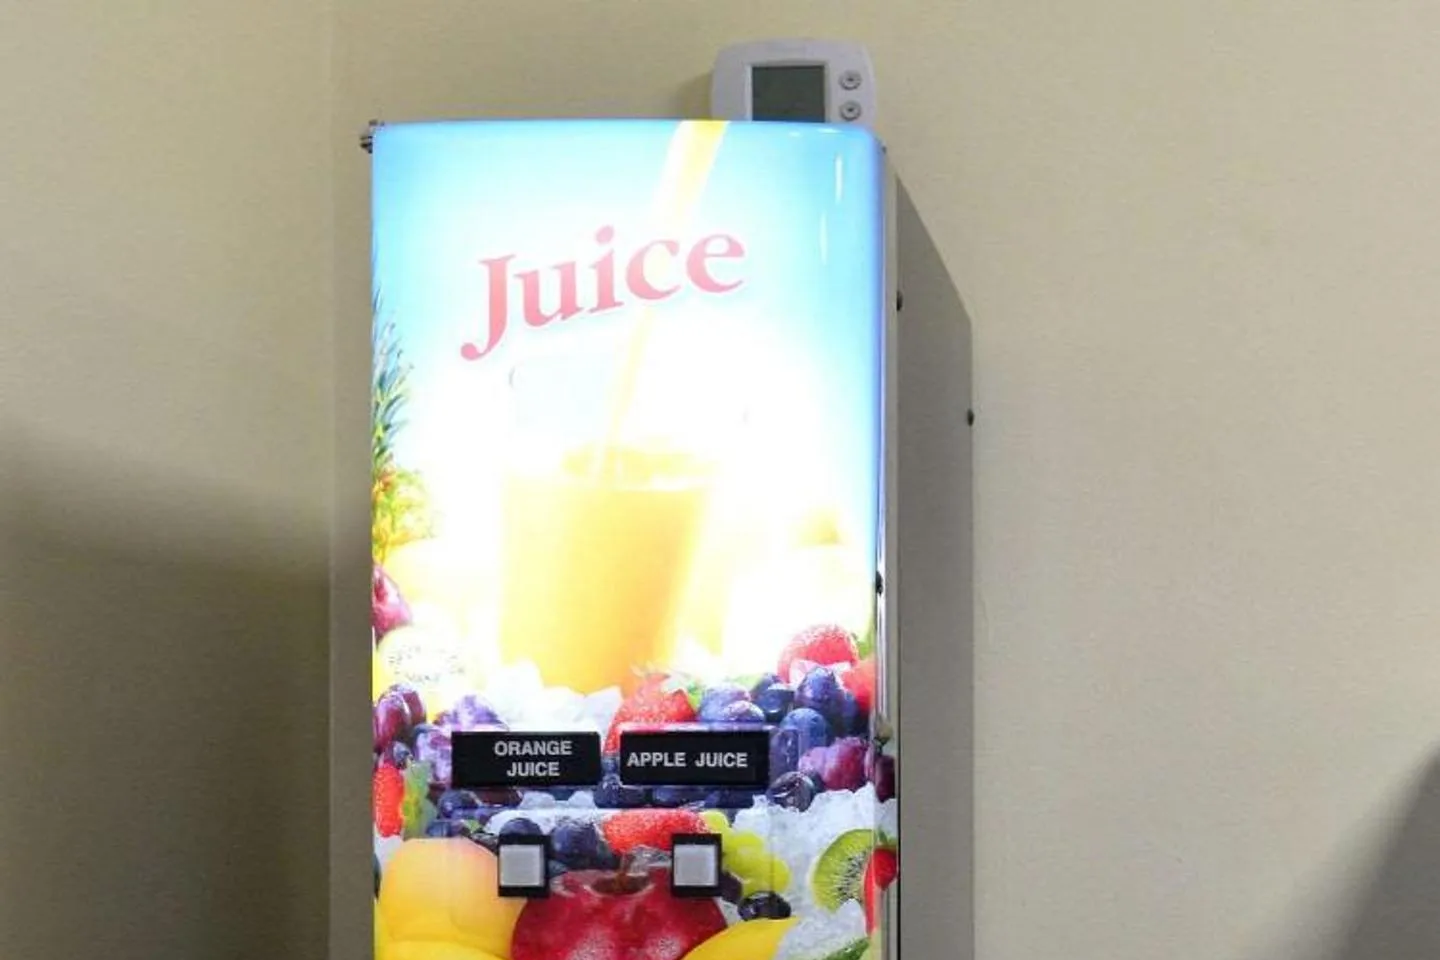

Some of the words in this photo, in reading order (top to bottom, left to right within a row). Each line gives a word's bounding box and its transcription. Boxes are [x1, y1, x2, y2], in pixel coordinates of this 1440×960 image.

[460, 225, 745, 361] Juice
[494, 740, 572, 756] ORANGE
[626, 752, 686, 767] APPLE
[695, 752, 748, 768] JUICE
[506, 761, 560, 777] JUICE
